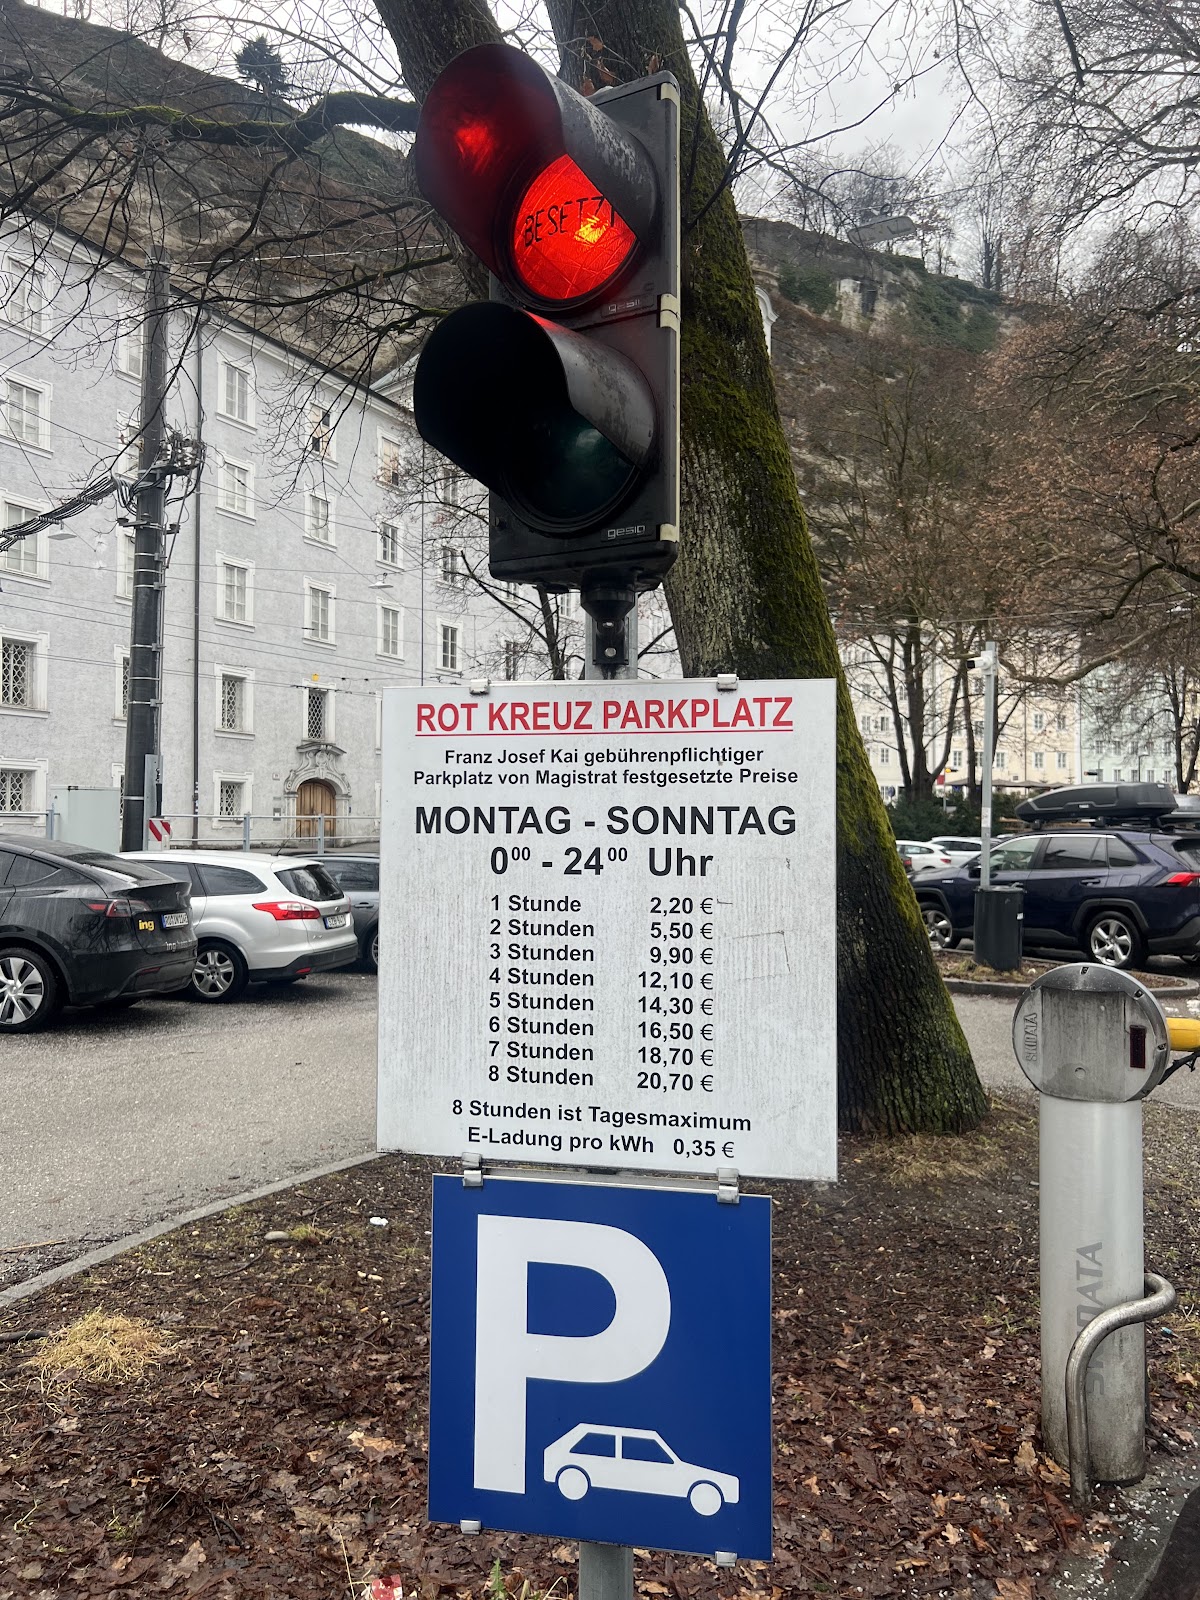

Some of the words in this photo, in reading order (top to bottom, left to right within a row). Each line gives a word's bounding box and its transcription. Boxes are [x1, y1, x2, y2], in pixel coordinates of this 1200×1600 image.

[416, 703, 478, 731] ROT
[488, 701, 592, 730] KREUZ
[603, 697, 793, 729] PARKPLATZ
[445, 750, 492, 764] Franz
[497, 749, 545, 763] Josef
[550, 749, 577, 763] Kai
[584, 747, 764, 766] gebührenpflichtiger
[414, 771, 492, 788] Parkplatz
[497, 774, 529, 784] von
[535, 770, 617, 788] Magistrat
[622, 769, 732, 787] festgesetzte
[739, 769, 798, 783] Preise
[415, 806, 570, 834] MONTAG
[606, 806, 795, 835] SONNTAG
[648, 848, 713, 876] Uhr
[491, 895, 498, 910] 1
[508, 895, 581, 912] Stunde
[649, 897, 693, 917] 2,20
[699, 898, 713, 914] €
[138, 919, 155, 931] ing
[489, 919, 500, 935] 2
[507, 919, 594, 936] Stunden
[650, 922, 693, 941] 5,50
[699, 923, 713, 939] €
[489, 943, 500, 959] 3
[507, 943, 593, 961] Stunden
[649, 947, 693, 966] 9,90
[699, 948, 713, 964] €
[488, 968, 500, 983] 4
[507, 968, 593, 986] Stunden
[638, 971, 693, 991] 12,10
[699, 973, 713, 990] €
[489, 992, 500, 1008] 5
[507, 992, 593, 1011] Stunden
[638, 996, 693, 1017] 14,30
[699, 998, 713, 1015] €
[488, 1016, 500, 1032] 6
[506, 1017, 593, 1036] Stunden
[637, 1021, 693, 1042] 16,50
[699, 1024, 713, 1041] €
[1023, 1012, 1038, 1062] SKIDATA
[488, 1041, 499, 1056] 7
[506, 1041, 593, 1060] Stunden
[637, 1047, 693, 1067] 18,70
[700, 1049, 713, 1066] €
[488, 1065, 499, 1081] 8
[506, 1066, 593, 1086] Stunden
[636, 1072, 693, 1093] 20,70
[699, 1075, 713, 1092] €
[452, 1100, 462, 1115] 8
[469, 1100, 550, 1119] Stunden
[558, 1106, 582, 1121] ist
[587, 1106, 750, 1131] Tagesmaximum
[468, 1127, 562, 1151] E-Ladung
[569, 1137, 602, 1152] pro
[609, 1135, 653, 1152] kWh
[673, 1139, 715, 1158] 0,35
[721, 1142, 734, 1158] €
[474, 1214, 671, 1494] P
